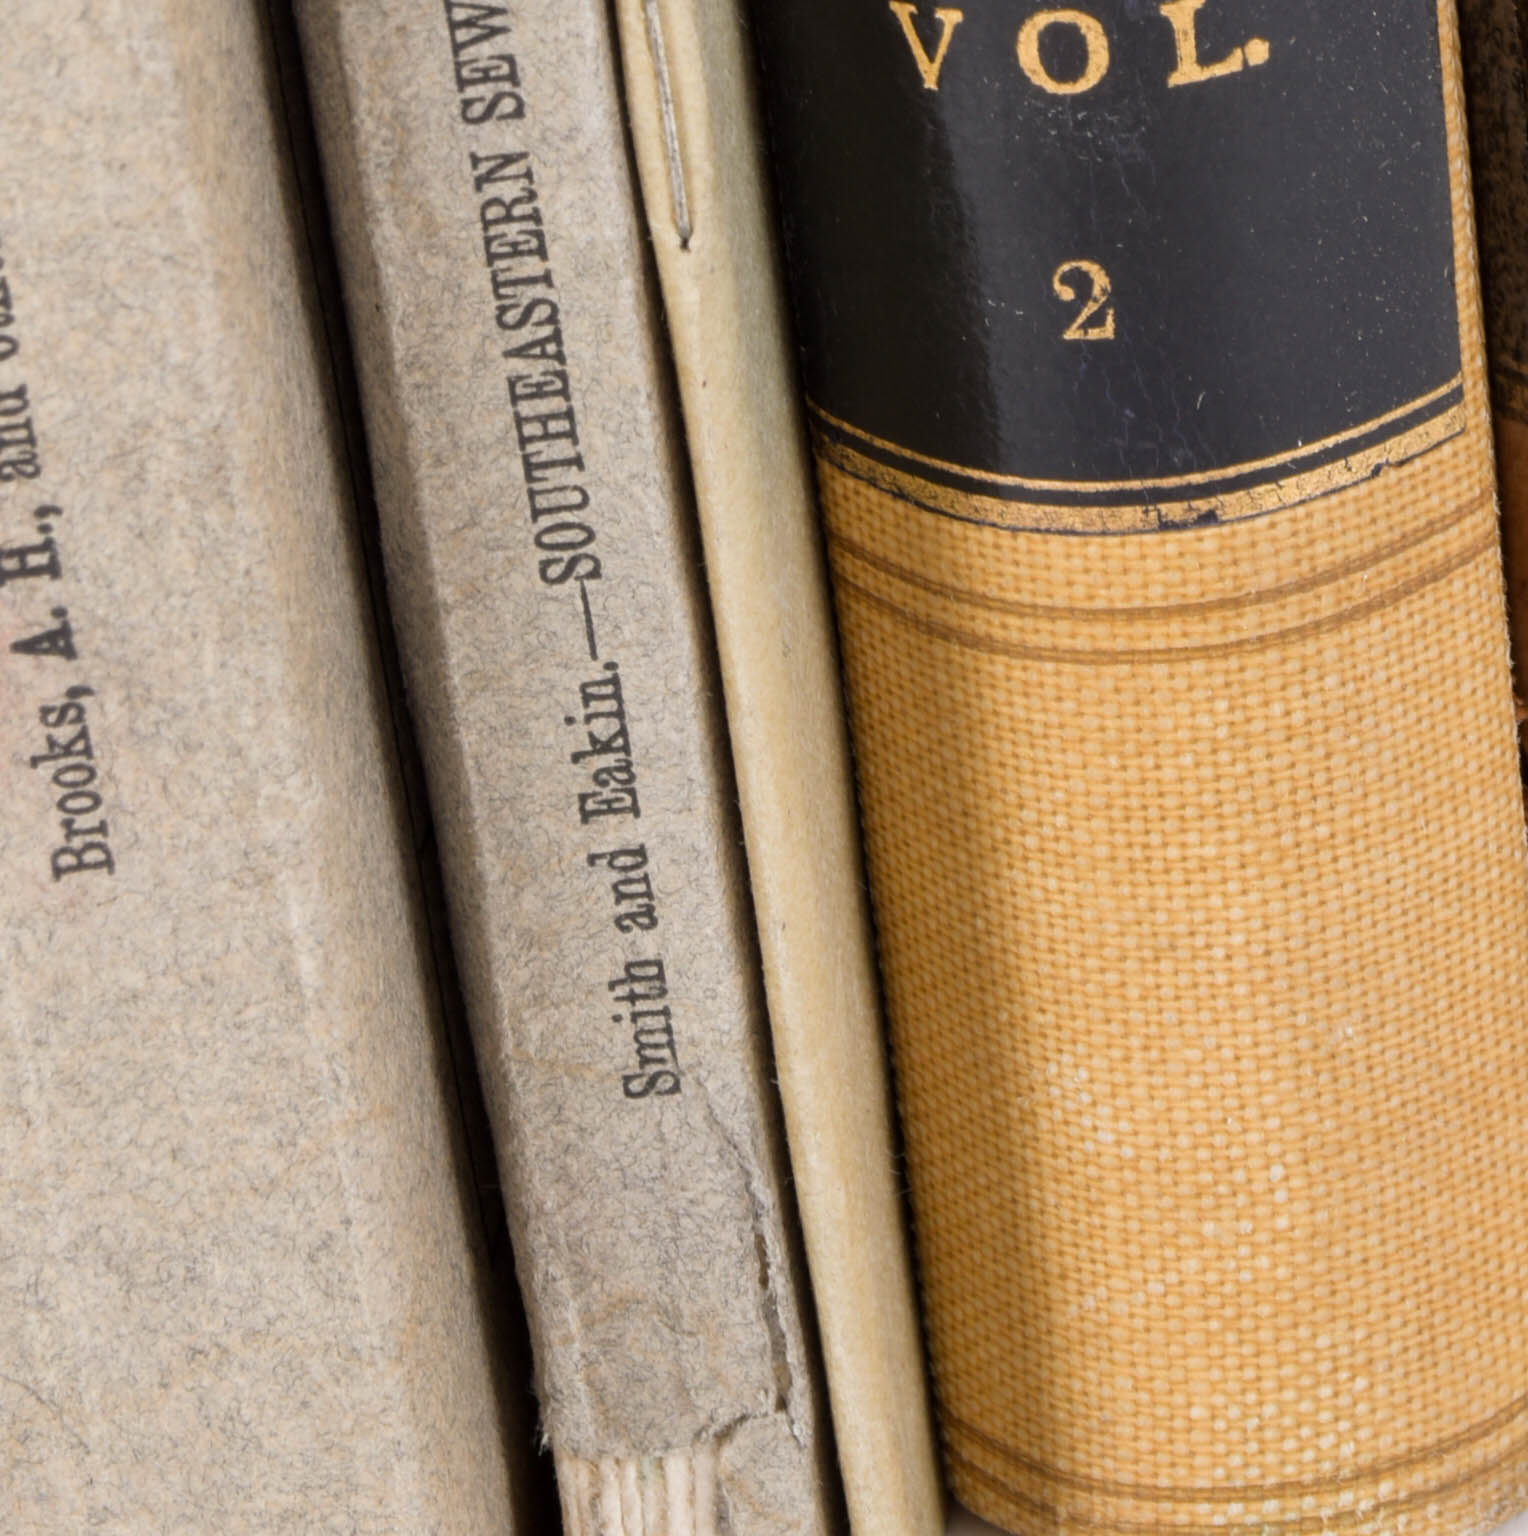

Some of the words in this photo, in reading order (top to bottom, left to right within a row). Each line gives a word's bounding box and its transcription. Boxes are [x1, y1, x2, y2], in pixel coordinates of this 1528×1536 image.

[1052, 260, 1116, 342] 2
[0, 504, 63, 588] H.,
[9, 607, 78, 661] A.
[31, 685, 115, 882] Brooks,
[588, 843, 658, 933] and
[620, 956, 681, 1101] Smith
